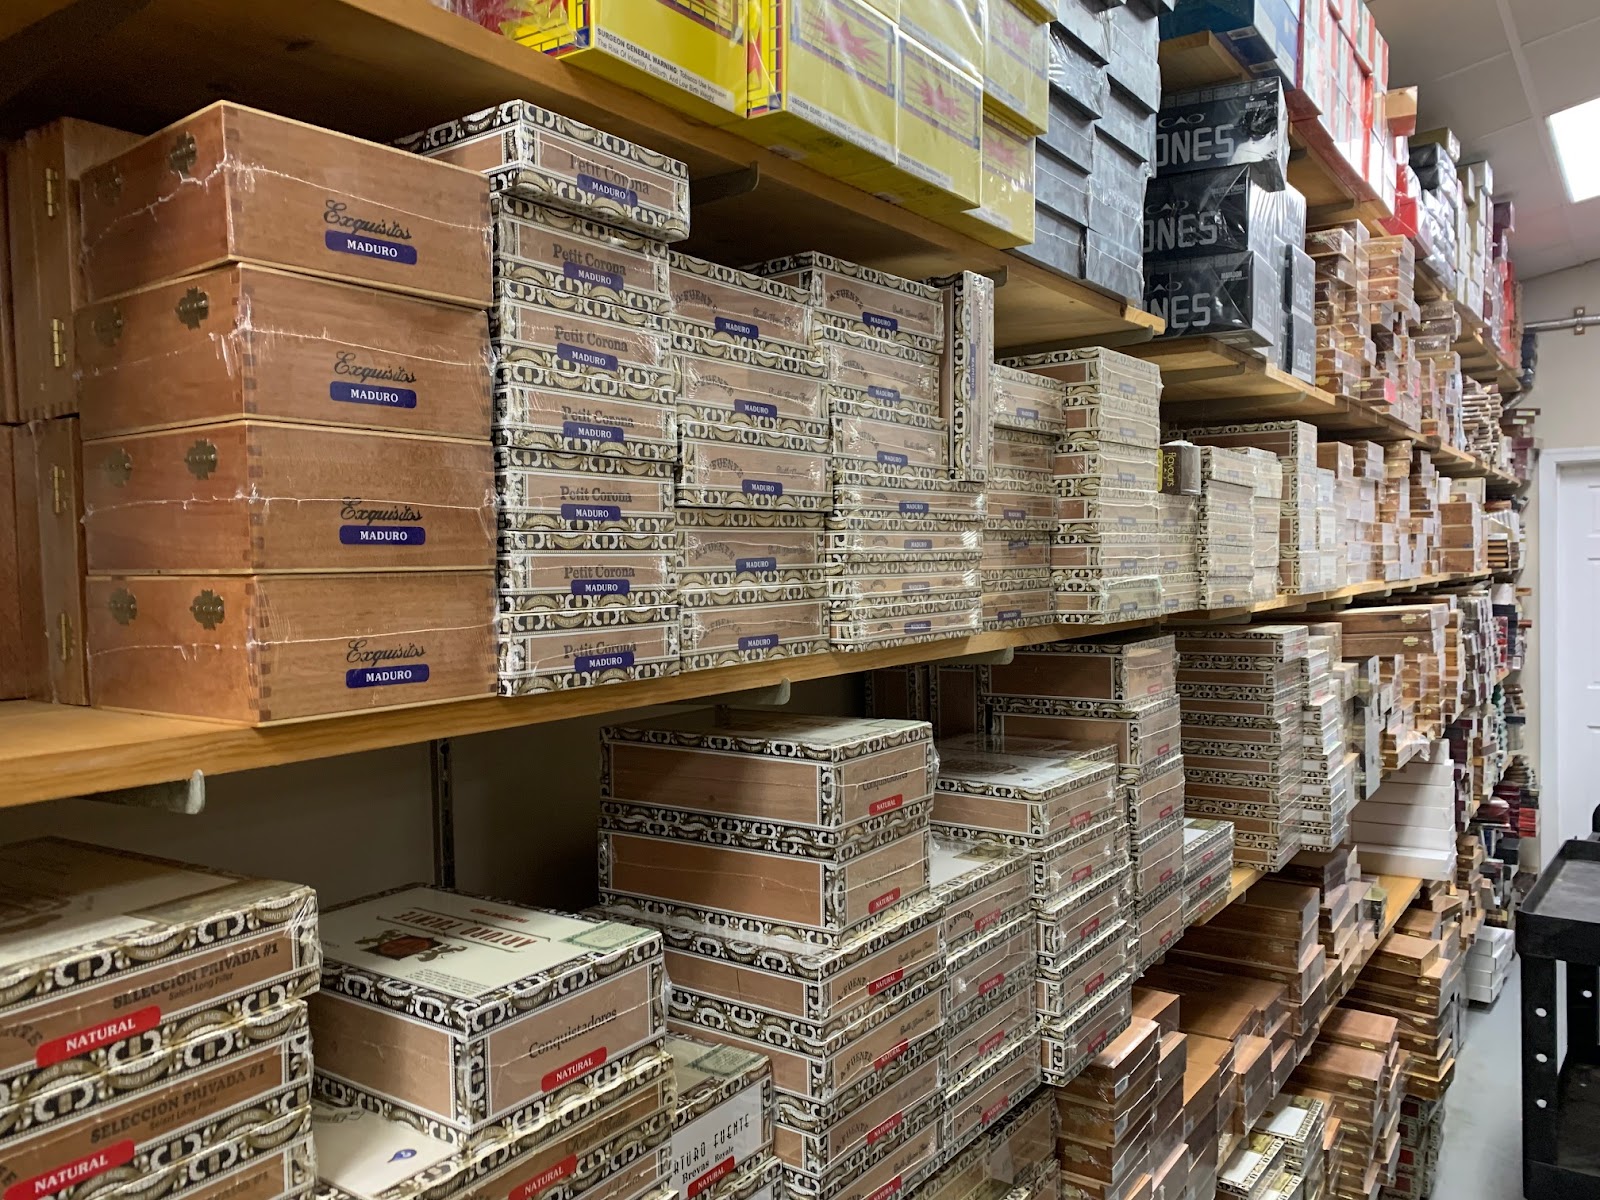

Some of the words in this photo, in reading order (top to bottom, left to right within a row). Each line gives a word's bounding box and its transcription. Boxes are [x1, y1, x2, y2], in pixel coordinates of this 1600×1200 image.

[597, 28, 625, 48] SURGEON
[626, 42, 652, 62] GENERAL
[680, 69, 698, 85] Tobacco
[1158, 112, 1204, 129] CAO
[570, 154, 601, 174] Petit
[604, 165, 650, 195] Corona
[592, 181, 626, 200] MADURO
[323, 200, 412, 239] Exquisitos
[347, 239, 398, 259] MADURO
[552, 243, 582, 267] Petit
[585, 253, 627, 276] Corona
[578, 270, 612, 285] MADURO
[726, 322, 750, 335] MADURO
[870, 316, 891, 327] MADURO
[554, 325, 586, 344] Petit
[588, 333, 628, 353] Corona
[334, 351, 417, 383] Exquisitos
[572, 350, 606, 367] MADURO
[350, 388, 399, 404] MADURO
[562, 405, 592, 423] Petit
[594, 411, 635, 429] Corona
[744, 404, 769, 415] MADURO
[578, 427, 612, 440] MADURO
[560, 485, 590, 502] Petit
[591, 487, 633, 503] Corona
[751, 484, 775, 492] MADURO
[340, 497, 423, 526] Exquisitos
[575, 508, 609, 518] MADURO
[360, 530, 408, 541] MADURO
[564, 566, 594, 579] Petit
[595, 564, 636, 578] Corona
[585, 583, 618, 592] MADURO
[346, 639, 427, 667] Exquisitos
[563, 644, 593, 659] Petit
[596, 641, 637, 655] Corona
[748, 639, 771, 647] MADURO
[589, 655, 623, 668] MADURO
[365, 669, 412, 682] MADURO
[876, 799, 896, 811] NATURAL
[876, 895, 894, 908] NATURAL
[392, 911, 455, 934] FUENTE
[459, 923, 538, 949] ARTURO
[113, 971, 197, 1010] SELECCION
[200, 950, 260, 982] PRIVADA
[263, 942, 279, 958] #1
[65, 1017, 136, 1052] NATURAL
[528, 1008, 617, 1059] Conquistadores
[556, 1057, 594, 1082] NATURAL
[91, 1100, 179, 1143] SELECCION
[183, 1068, 247, 1106] PRIVADA
[251, 1063, 266, 1077] #1
[714, 1113, 750, 1149] FUENTE
[34, 1154, 109, 1194] NATURAL
[682, 1157, 709, 1185] Brevas
[714, 1146, 734, 1163] Royale
[524, 1166, 564, 1195] NATURAL
[697, 1166, 726, 1190] NATURAL
